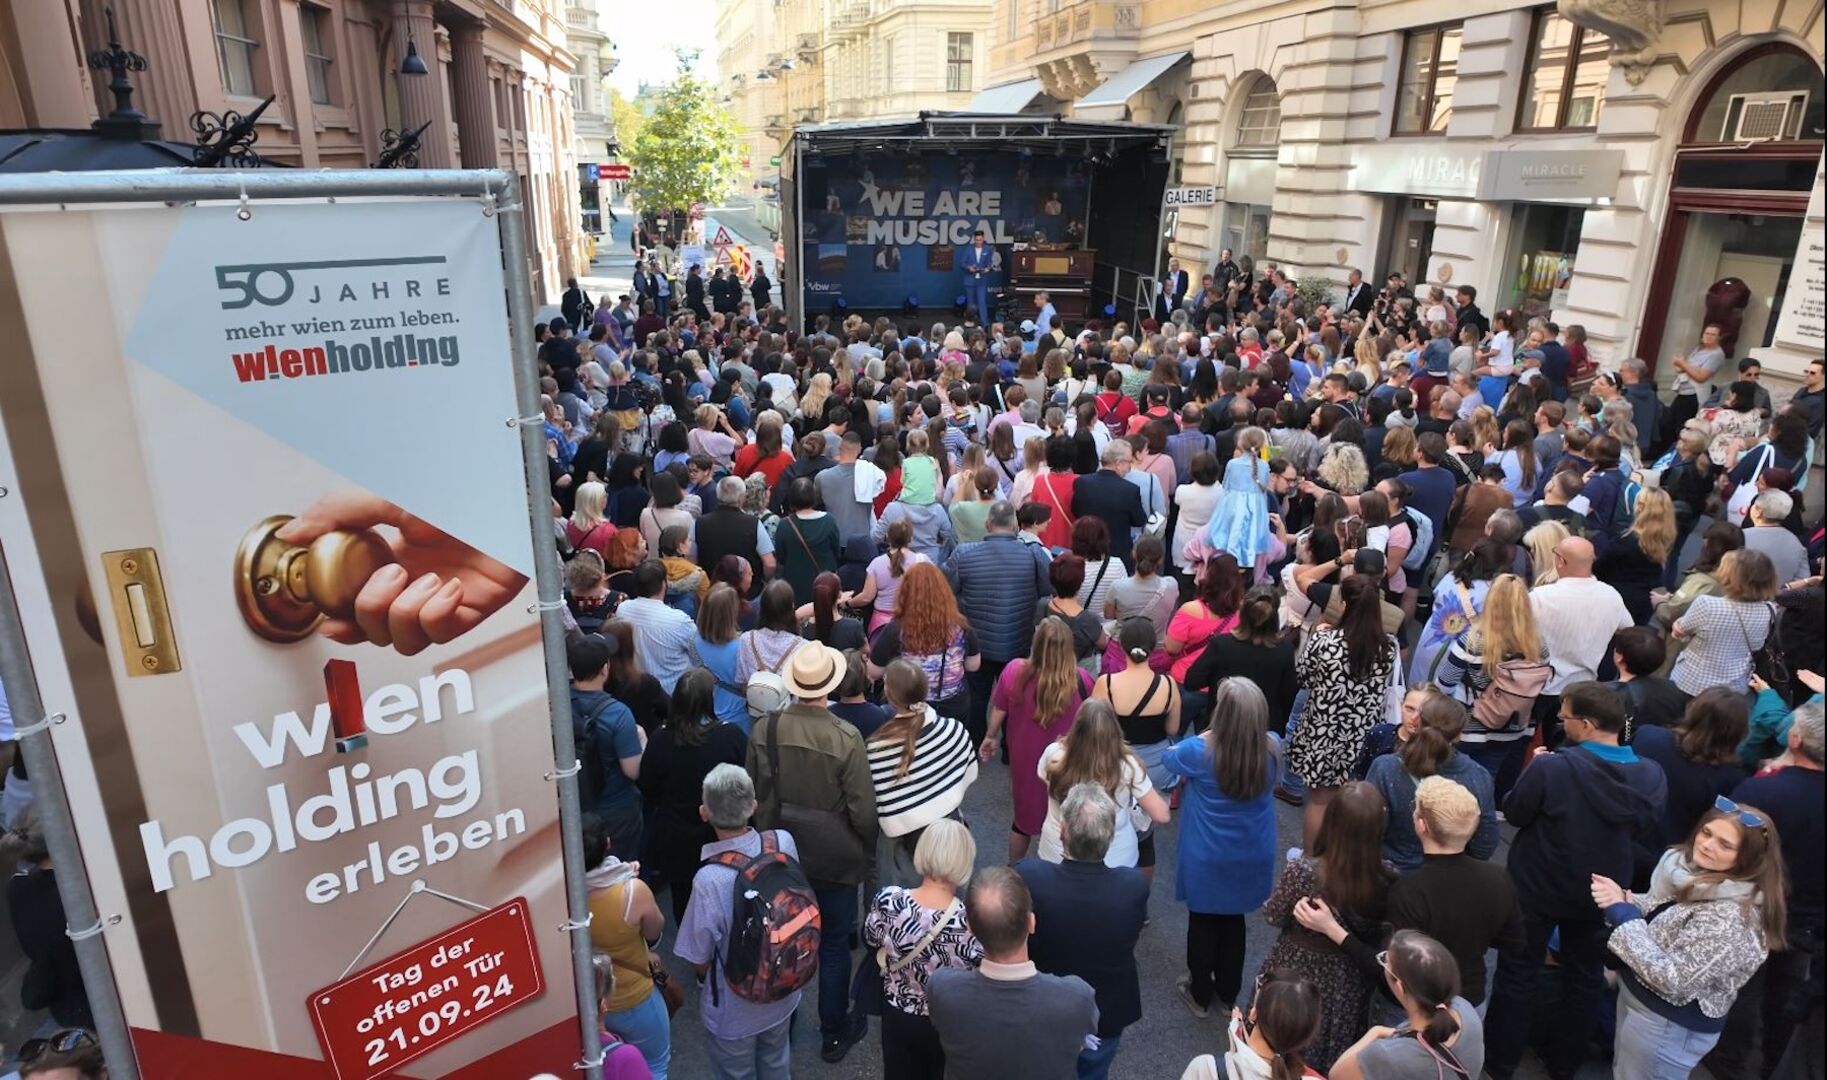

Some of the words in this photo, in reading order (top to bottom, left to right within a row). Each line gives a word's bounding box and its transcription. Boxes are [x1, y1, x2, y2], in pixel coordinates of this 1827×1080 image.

[1521, 163, 1586, 177] MIRACLE
[872, 190, 925, 216] WE
[932, 190, 1001, 216] ARE
[1166, 189, 1213, 204] GALERIE
[867, 219, 1014, 246] MUSICAL
[215, 262, 294, 310] 50
[309, 278, 450, 303] JAHRE
[225, 321, 286, 341] mehr
[291, 317, 346, 336] wien
[350, 317, 396, 331] zum
[400, 310, 460, 327] leben.
[139, 750, 483, 893] holding
[305, 808, 526, 904] erleben
[372, 962, 423, 994] Tag
[430, 938, 474, 968] der
[356, 975, 459, 1033] offenen
[463, 951, 505, 978] Tür
[364, 973, 514, 1067] 21.09.24
